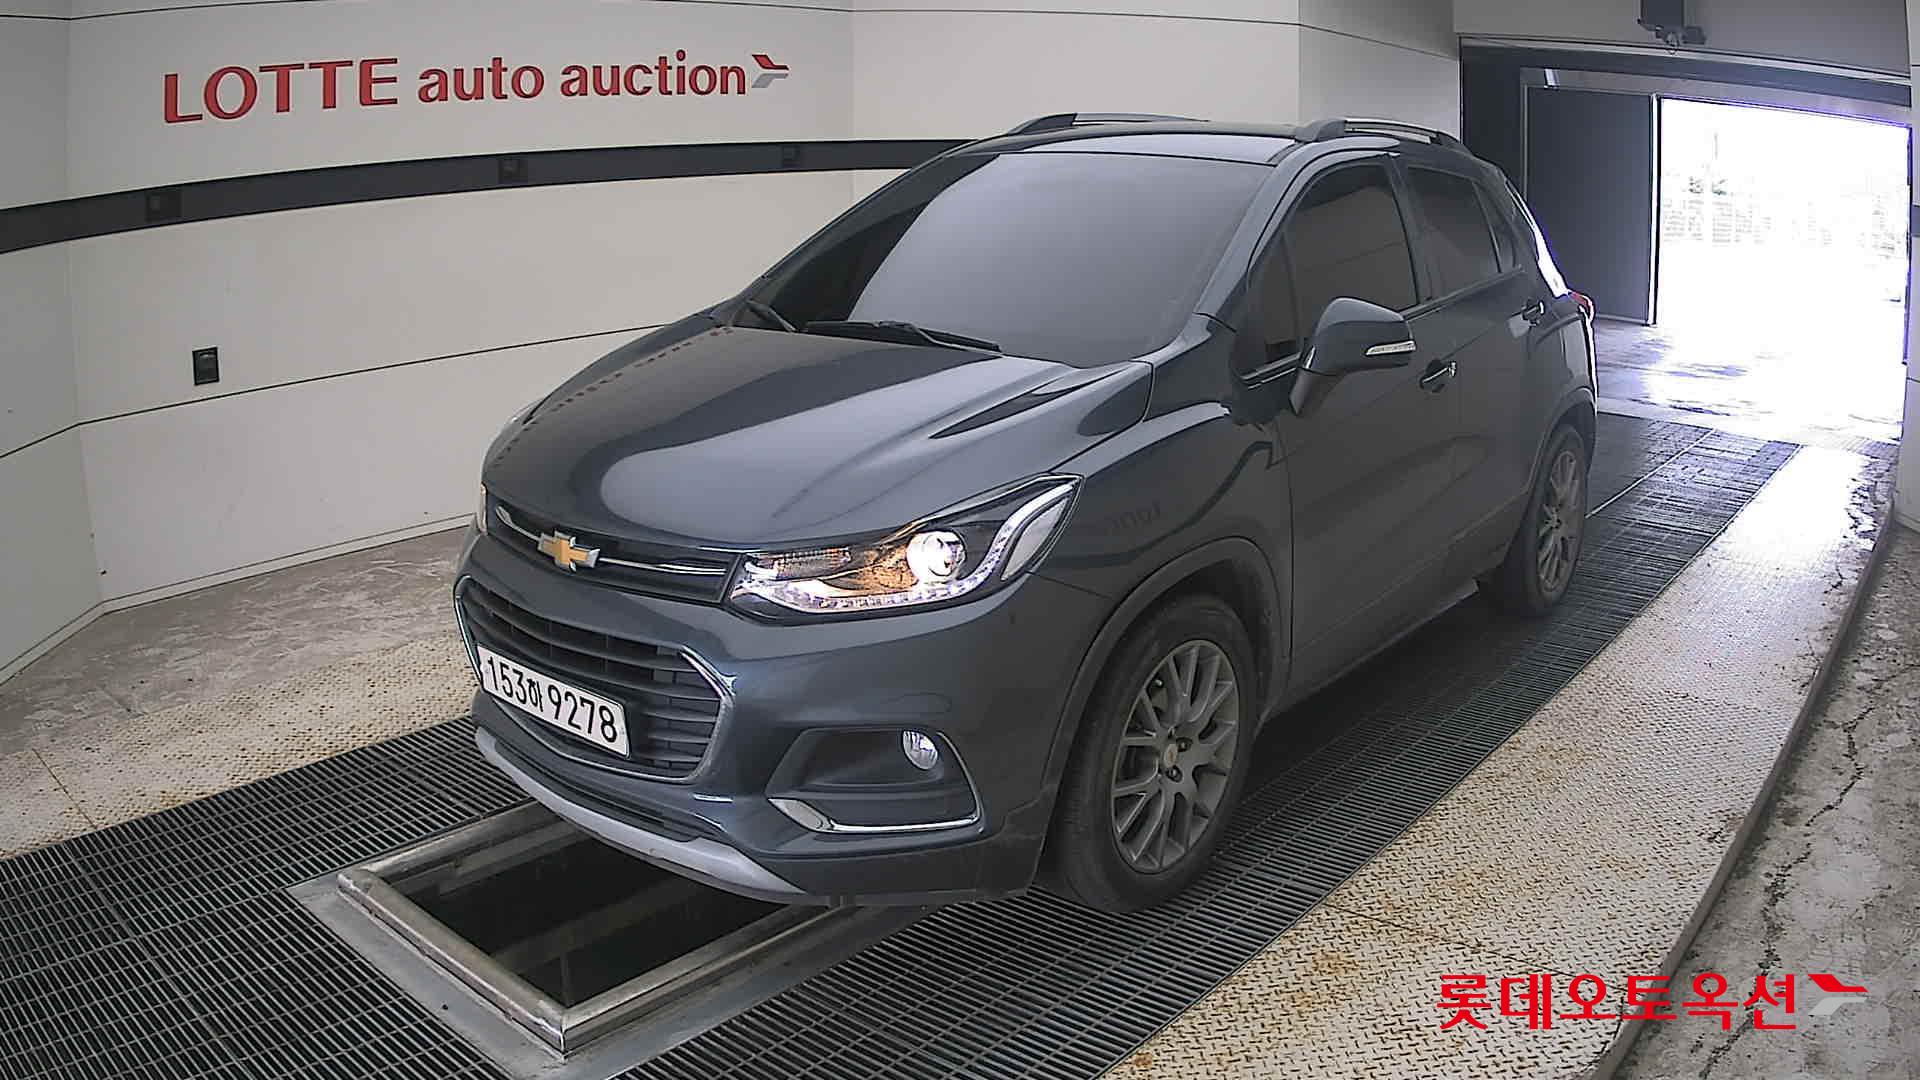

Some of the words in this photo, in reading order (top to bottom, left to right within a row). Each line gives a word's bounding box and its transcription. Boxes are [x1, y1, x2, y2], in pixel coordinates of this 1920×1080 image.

[163, 57, 398, 123] LOTTE
[418, 57, 545, 103] auto
[560, 50, 747, 97] auction
[548, 684, 618, 743] 9278
